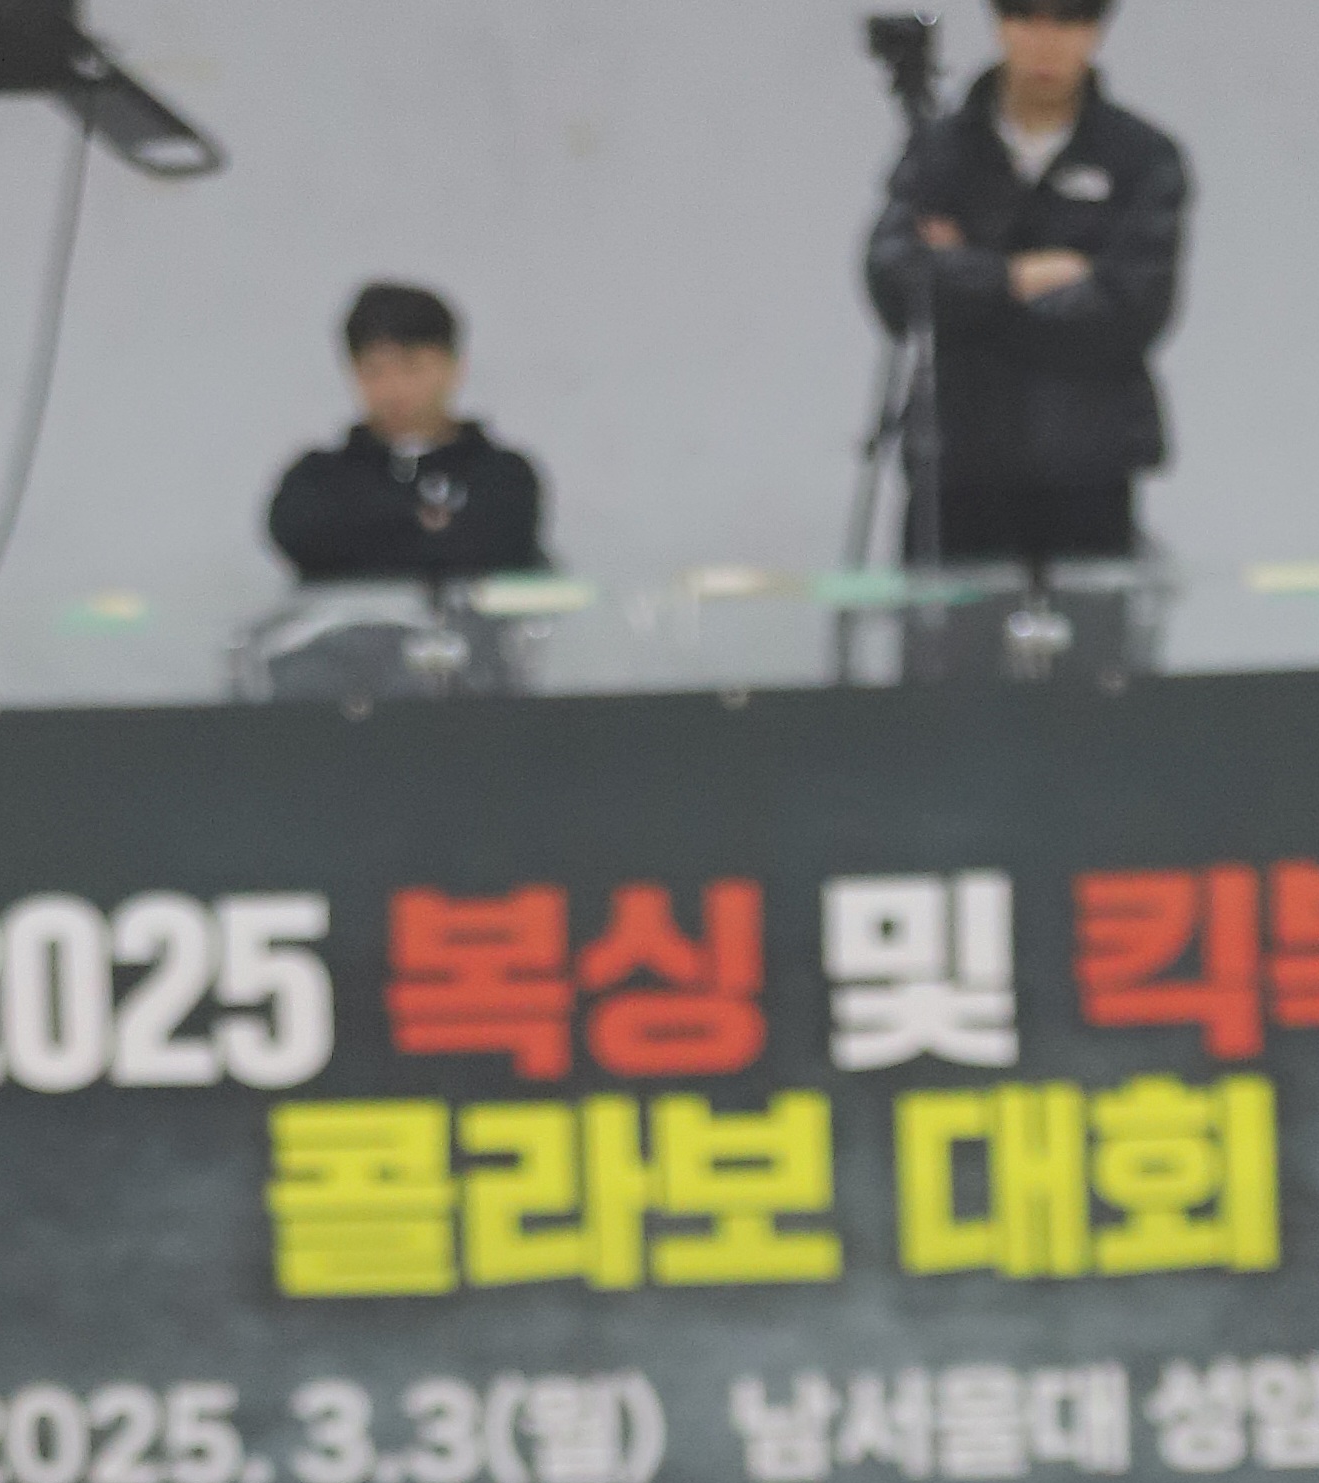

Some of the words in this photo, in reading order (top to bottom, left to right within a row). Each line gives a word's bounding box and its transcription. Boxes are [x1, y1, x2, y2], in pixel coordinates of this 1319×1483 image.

[386, 880, 766, 1080] 복싱
[823, 871, 1020, 1072] 및
[268, 1090, 842, 1297] 콜라보
[895, 1074, 1281, 1279] 대회
